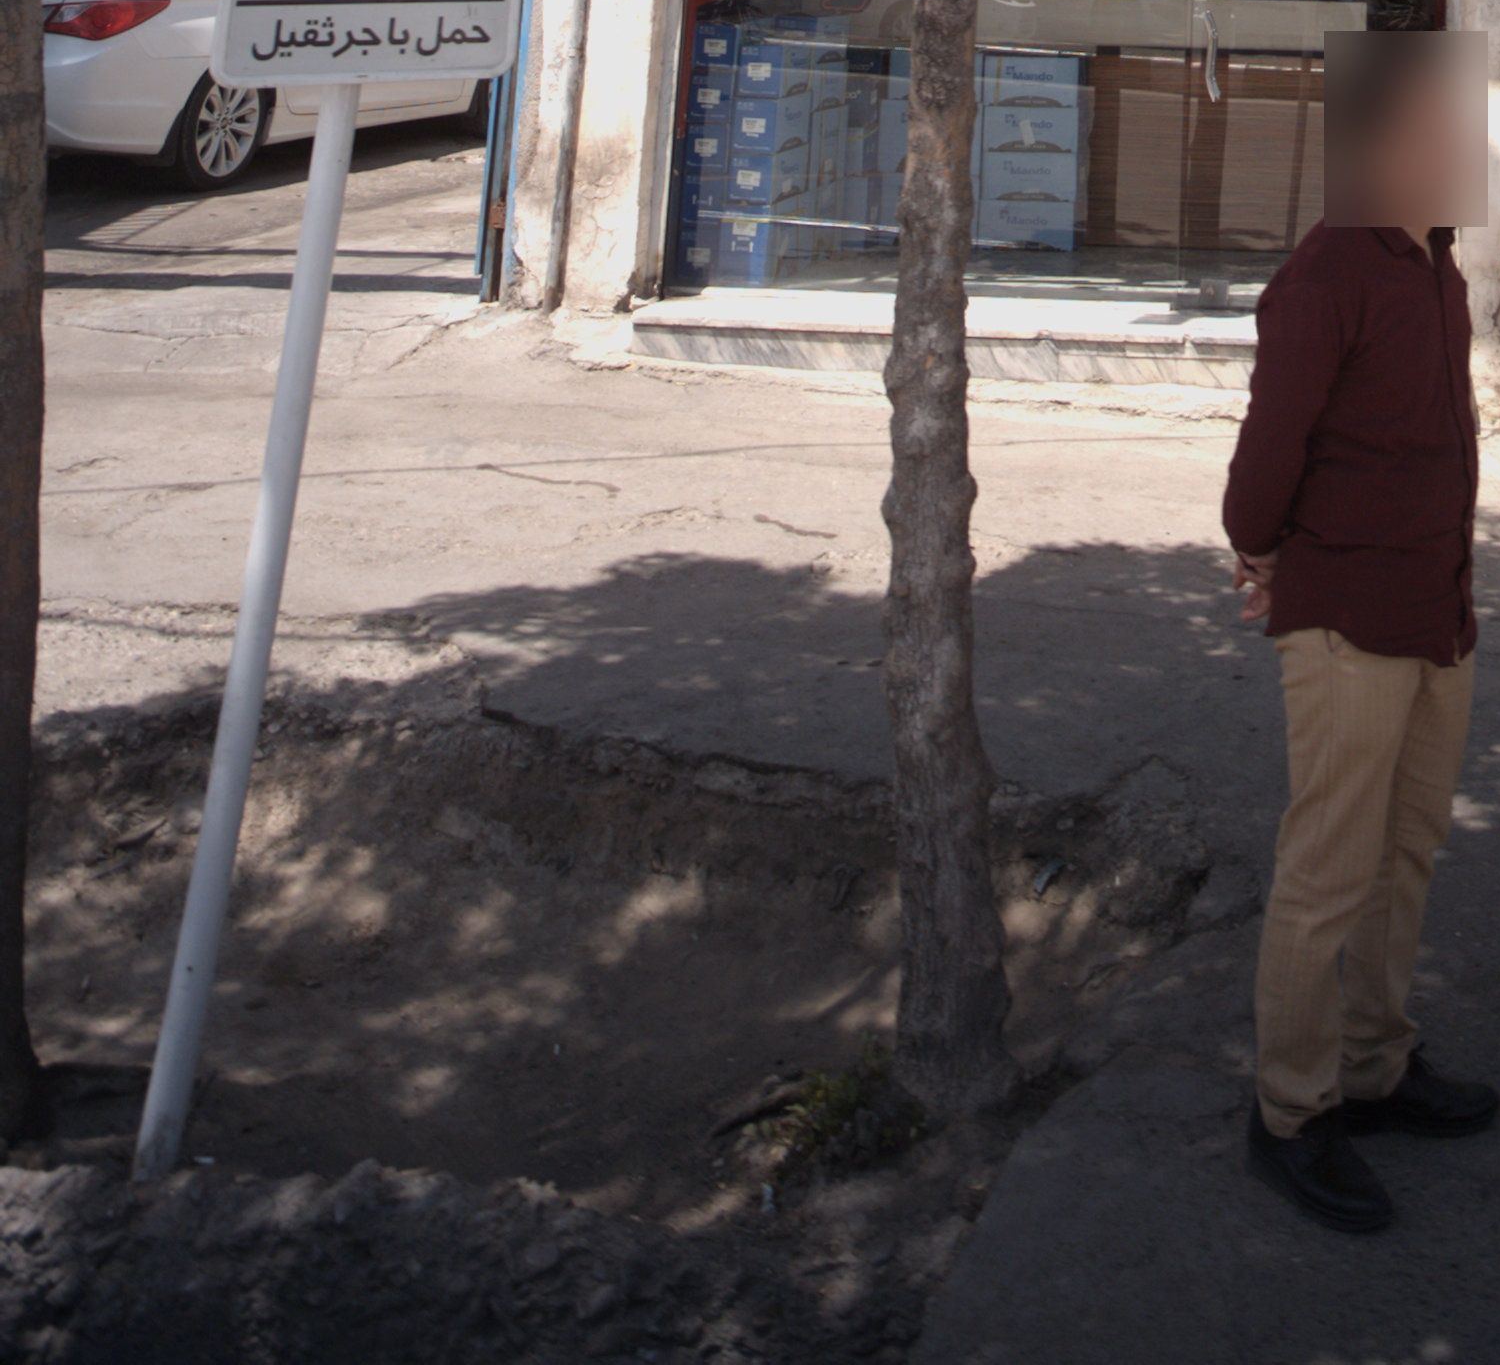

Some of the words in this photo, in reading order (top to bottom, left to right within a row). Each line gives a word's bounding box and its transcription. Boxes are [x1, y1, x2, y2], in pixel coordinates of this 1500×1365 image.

[252, 15, 379, 61] جرثقیل
[388, 17, 410, 51] با
[415, 16, 491, 58] حمل
